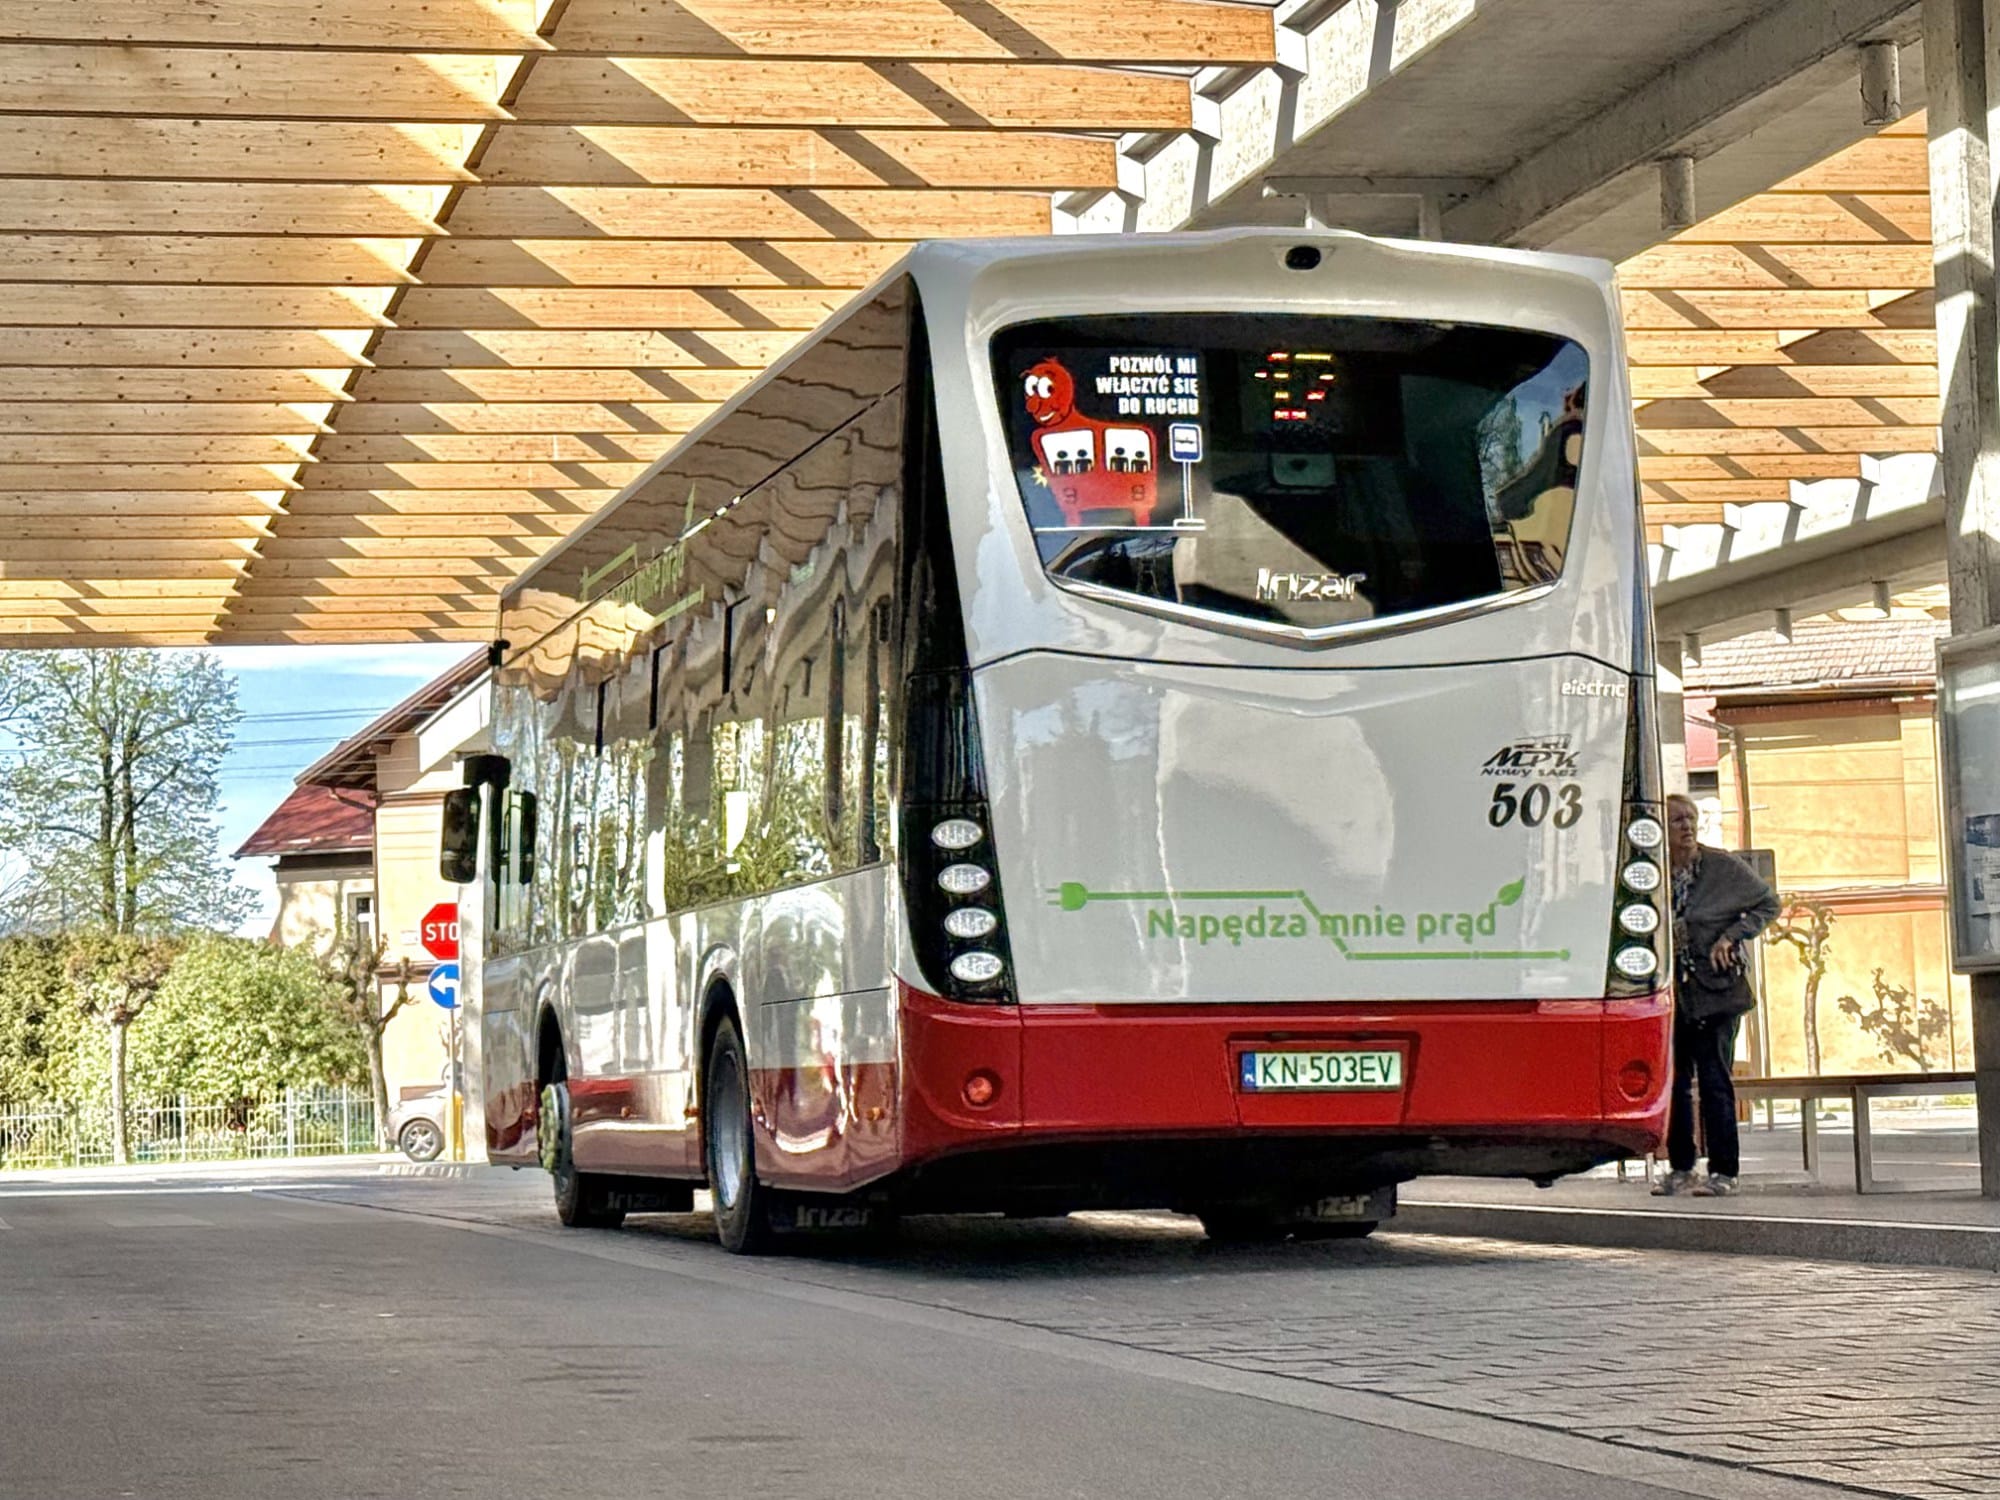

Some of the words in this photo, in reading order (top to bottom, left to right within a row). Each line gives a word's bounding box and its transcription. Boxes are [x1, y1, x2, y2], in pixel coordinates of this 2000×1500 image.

[1109, 354, 1174, 374] POZWÓL
[1177, 357, 1197, 374] MI
[1095, 374, 1170, 396] WŁĄCZYĆ
[1173, 377, 1199, 397] SIĘ
[1118, 397, 1141, 415] DO
[1145, 398, 1199, 416] RUCHU
[1256, 567, 1367, 601] Irizar
[1561, 679, 1626, 697] electric
[1482, 747, 1582, 768] MPK
[1488, 782, 1584, 830] 503
[426, 922, 459, 942] STO
[1148, 906, 1307, 946] Napędza
[1319, 904, 1406, 937] mnie
[1416, 902, 1496, 945] prąd
[1262, 1056, 1299, 1083] KN
[1309, 1056, 1393, 1083] 503EV
